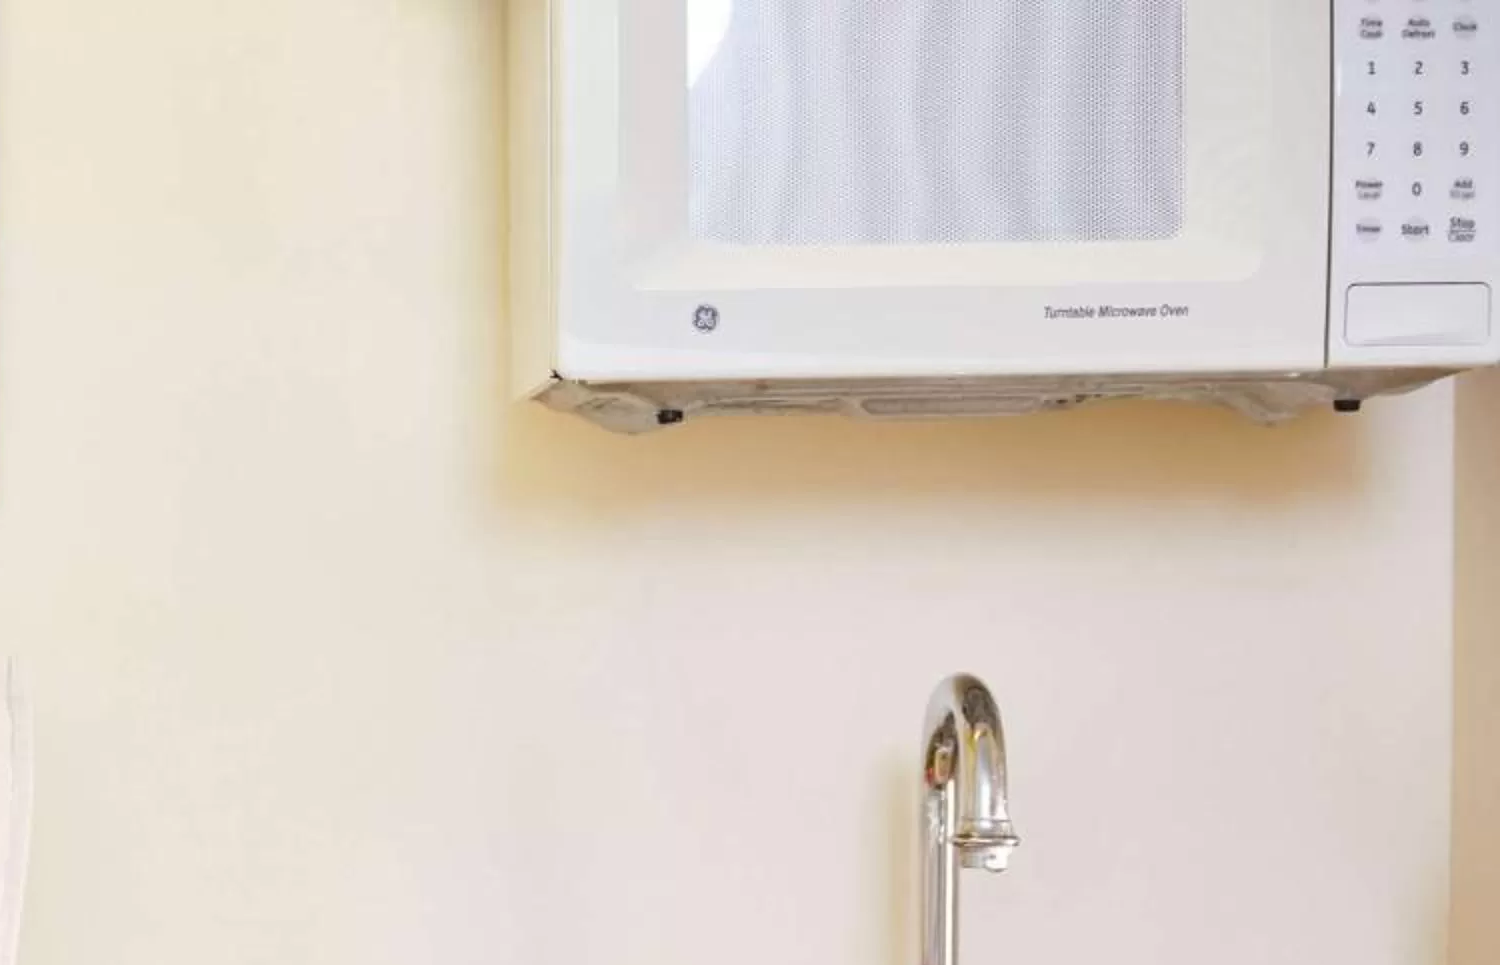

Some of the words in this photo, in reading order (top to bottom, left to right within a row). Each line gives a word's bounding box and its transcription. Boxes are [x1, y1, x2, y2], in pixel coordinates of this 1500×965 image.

[1367, 60, 1376, 75] 1
[1414, 60, 1423, 75] 2
[1460, 60, 1469, 75] 3
[1366, 101, 1376, 115] 4
[1413, 101, 1423, 115] 5
[1459, 101, 1469, 115] 6
[1366, 141, 1376, 157] 7
[1413, 141, 1422, 157] 8
[1459, 141, 1469, 156] 9
[1411, 181, 1422, 197] 0
[1043, 304, 1096, 319] Turntable
[1097, 304, 1157, 318] Microwave
[1159, 302, 1189, 318] Oven
